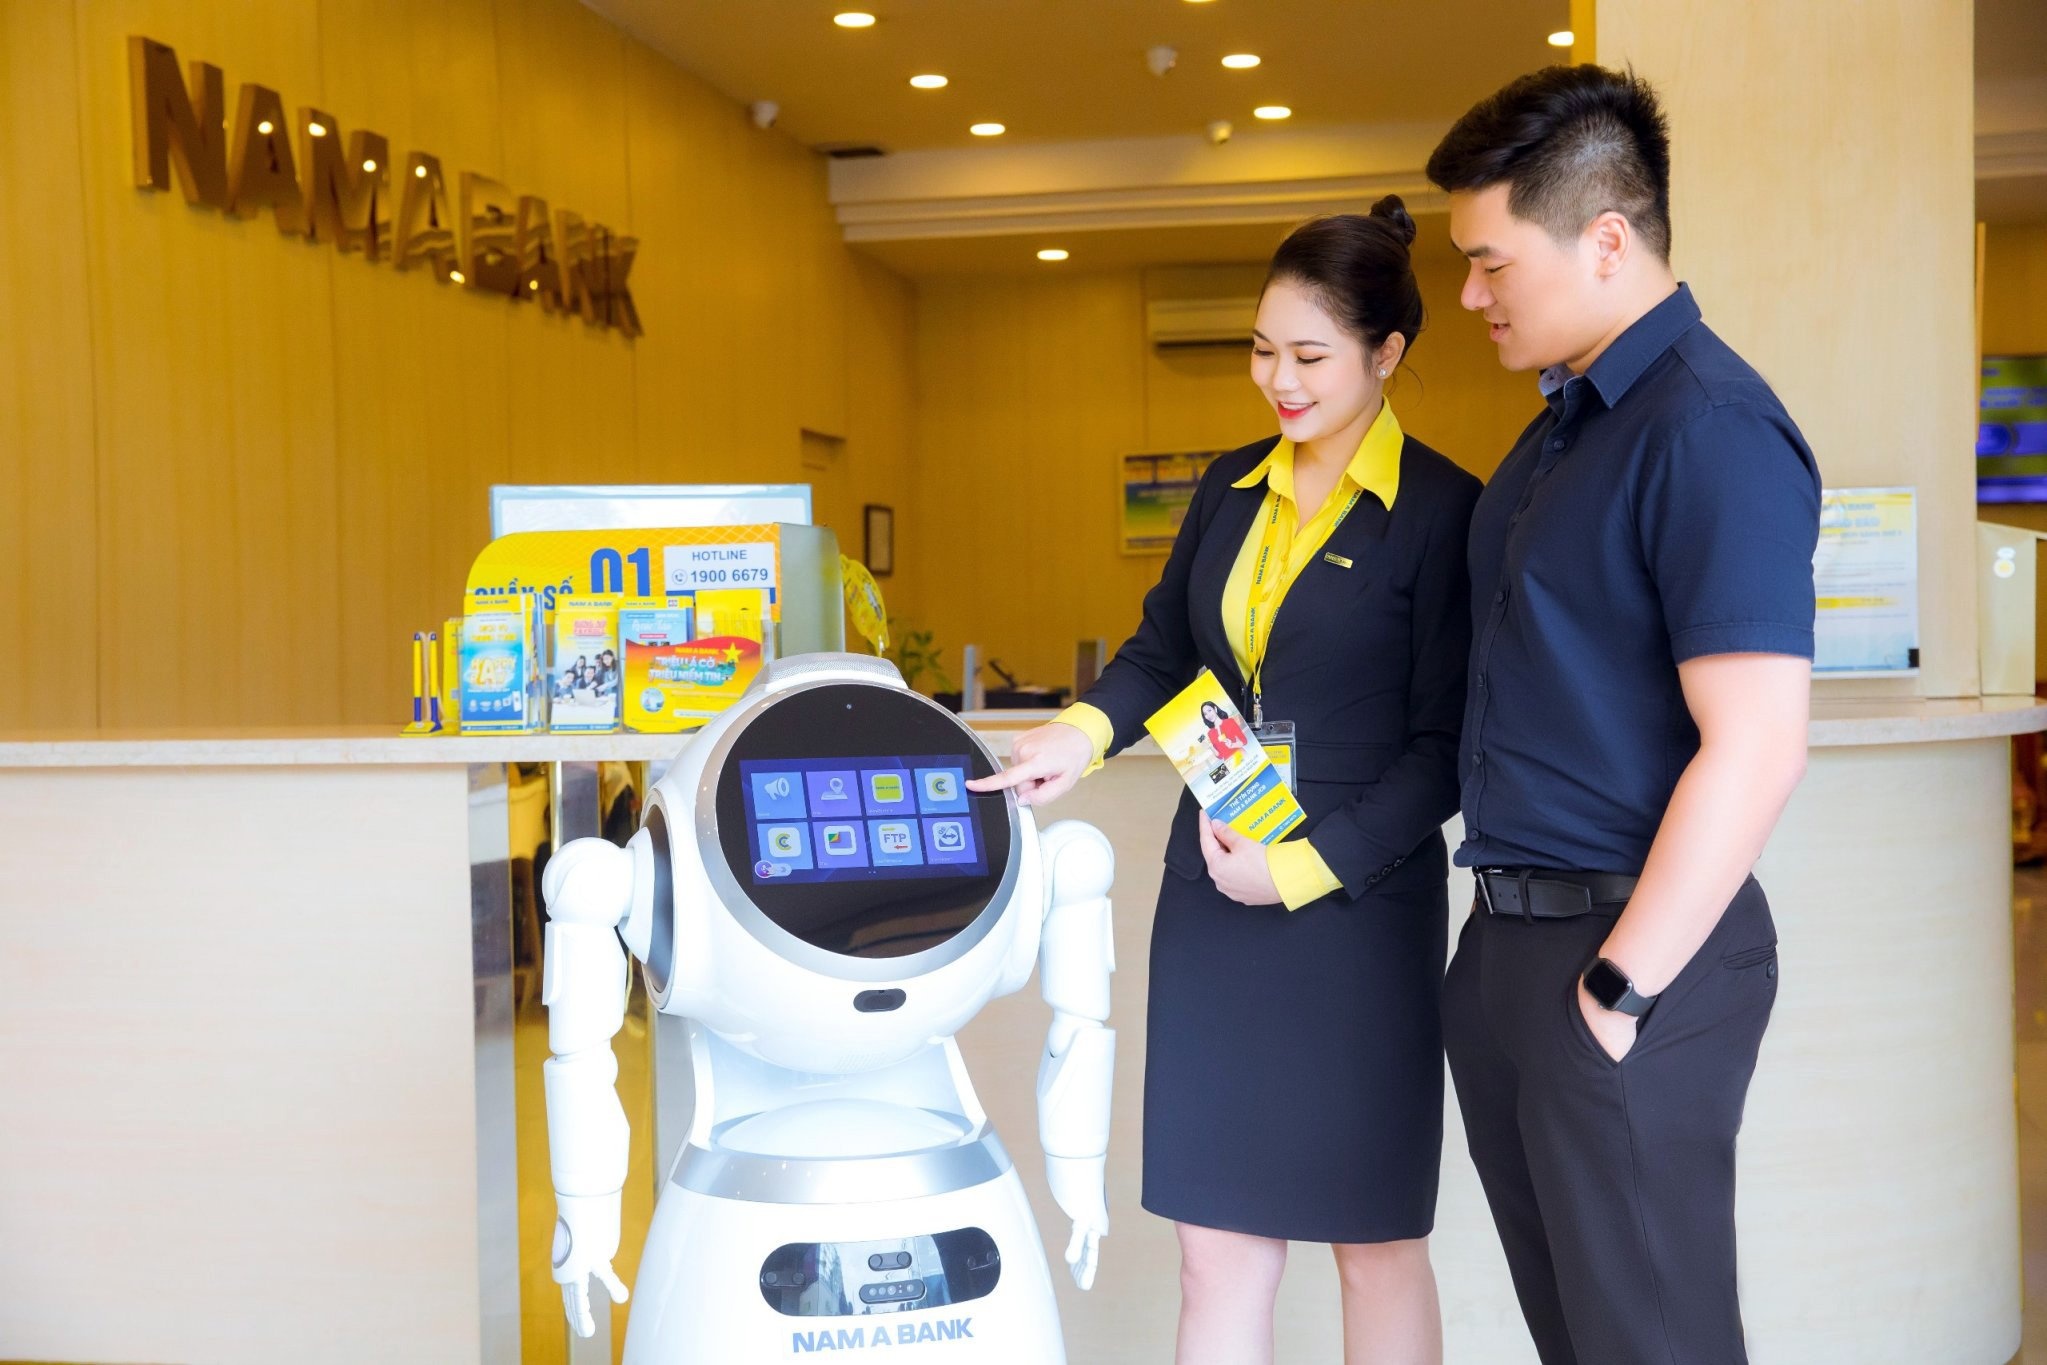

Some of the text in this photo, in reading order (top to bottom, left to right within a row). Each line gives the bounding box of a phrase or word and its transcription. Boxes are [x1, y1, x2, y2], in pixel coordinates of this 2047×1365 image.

[692, 549, 748, 562] HOTLINE
[590, 547, 650, 597] 01
[690, 568, 769, 584] 1900 6679
[1248, 815, 1265, 831] NAM
[1268, 797, 1286, 814] BANK
[883, 833, 907, 844] FTP
[792, 1317, 975, 1354] NAM A BANK
